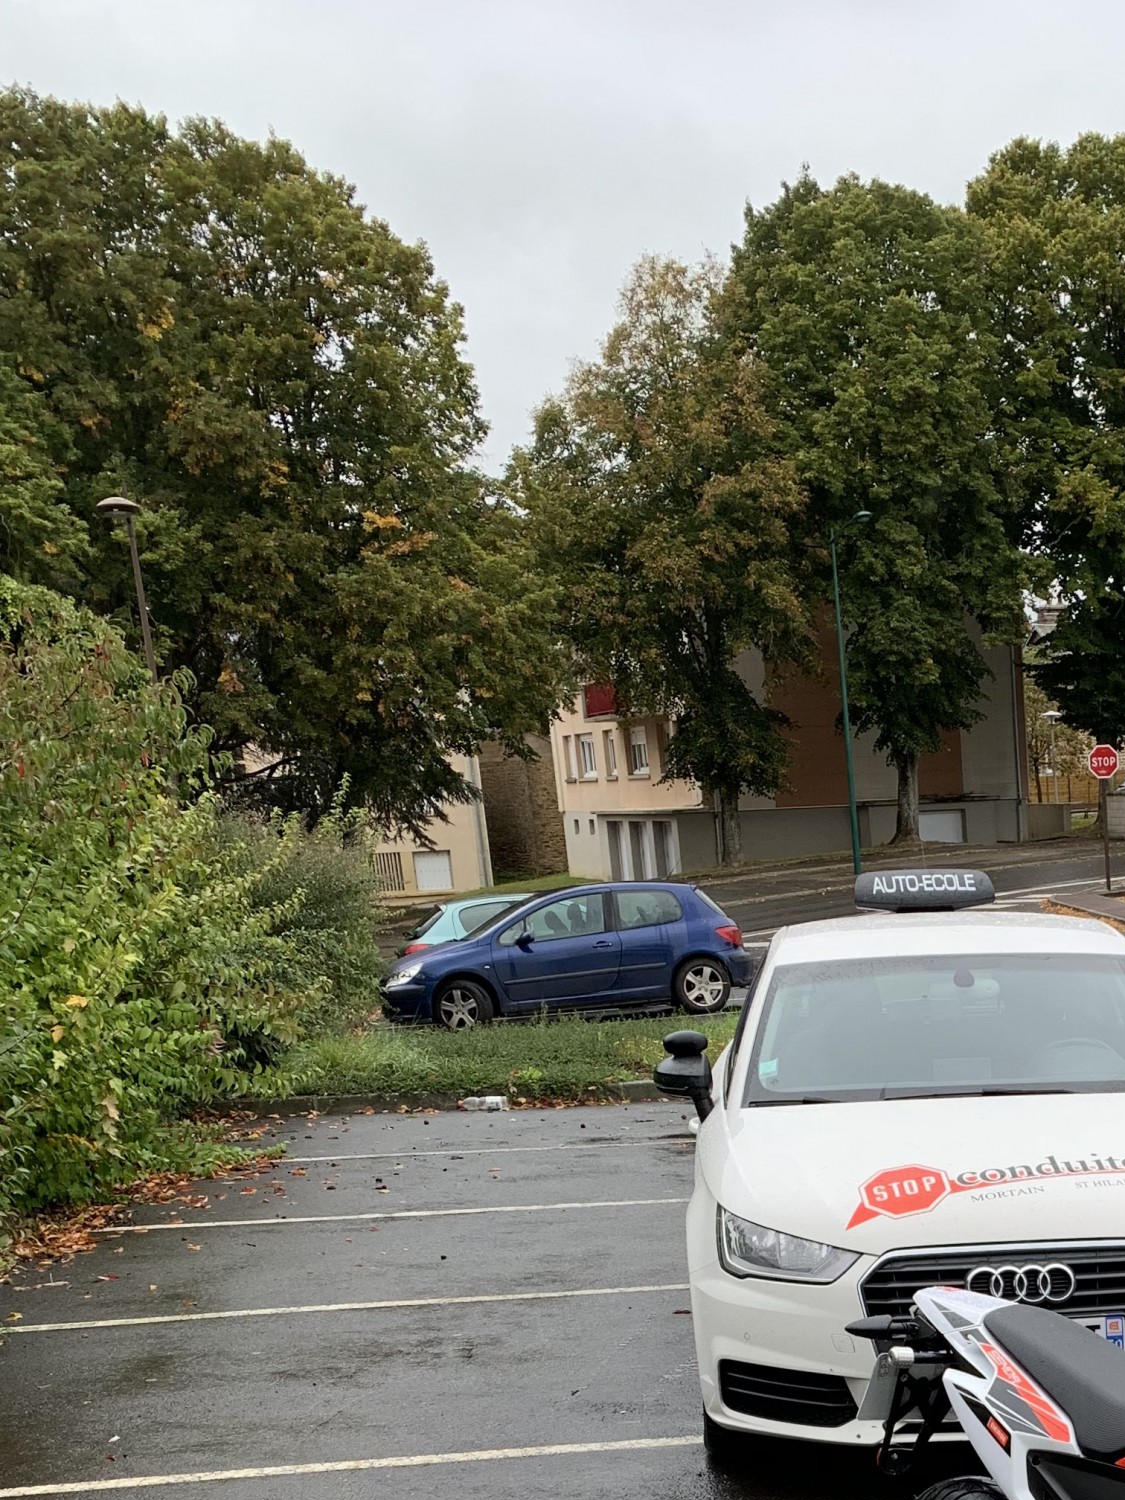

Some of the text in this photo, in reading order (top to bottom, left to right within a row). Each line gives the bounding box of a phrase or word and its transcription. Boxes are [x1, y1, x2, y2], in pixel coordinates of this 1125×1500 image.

[1091, 756, 1116, 767] STOP
[872, 873, 977, 895] AUTO-ECOLE
[872, 1175, 937, 1203] STOP
[1074, 1180, 1090, 1189] ST
[970, 1185, 1045, 1203] MORTAIN
